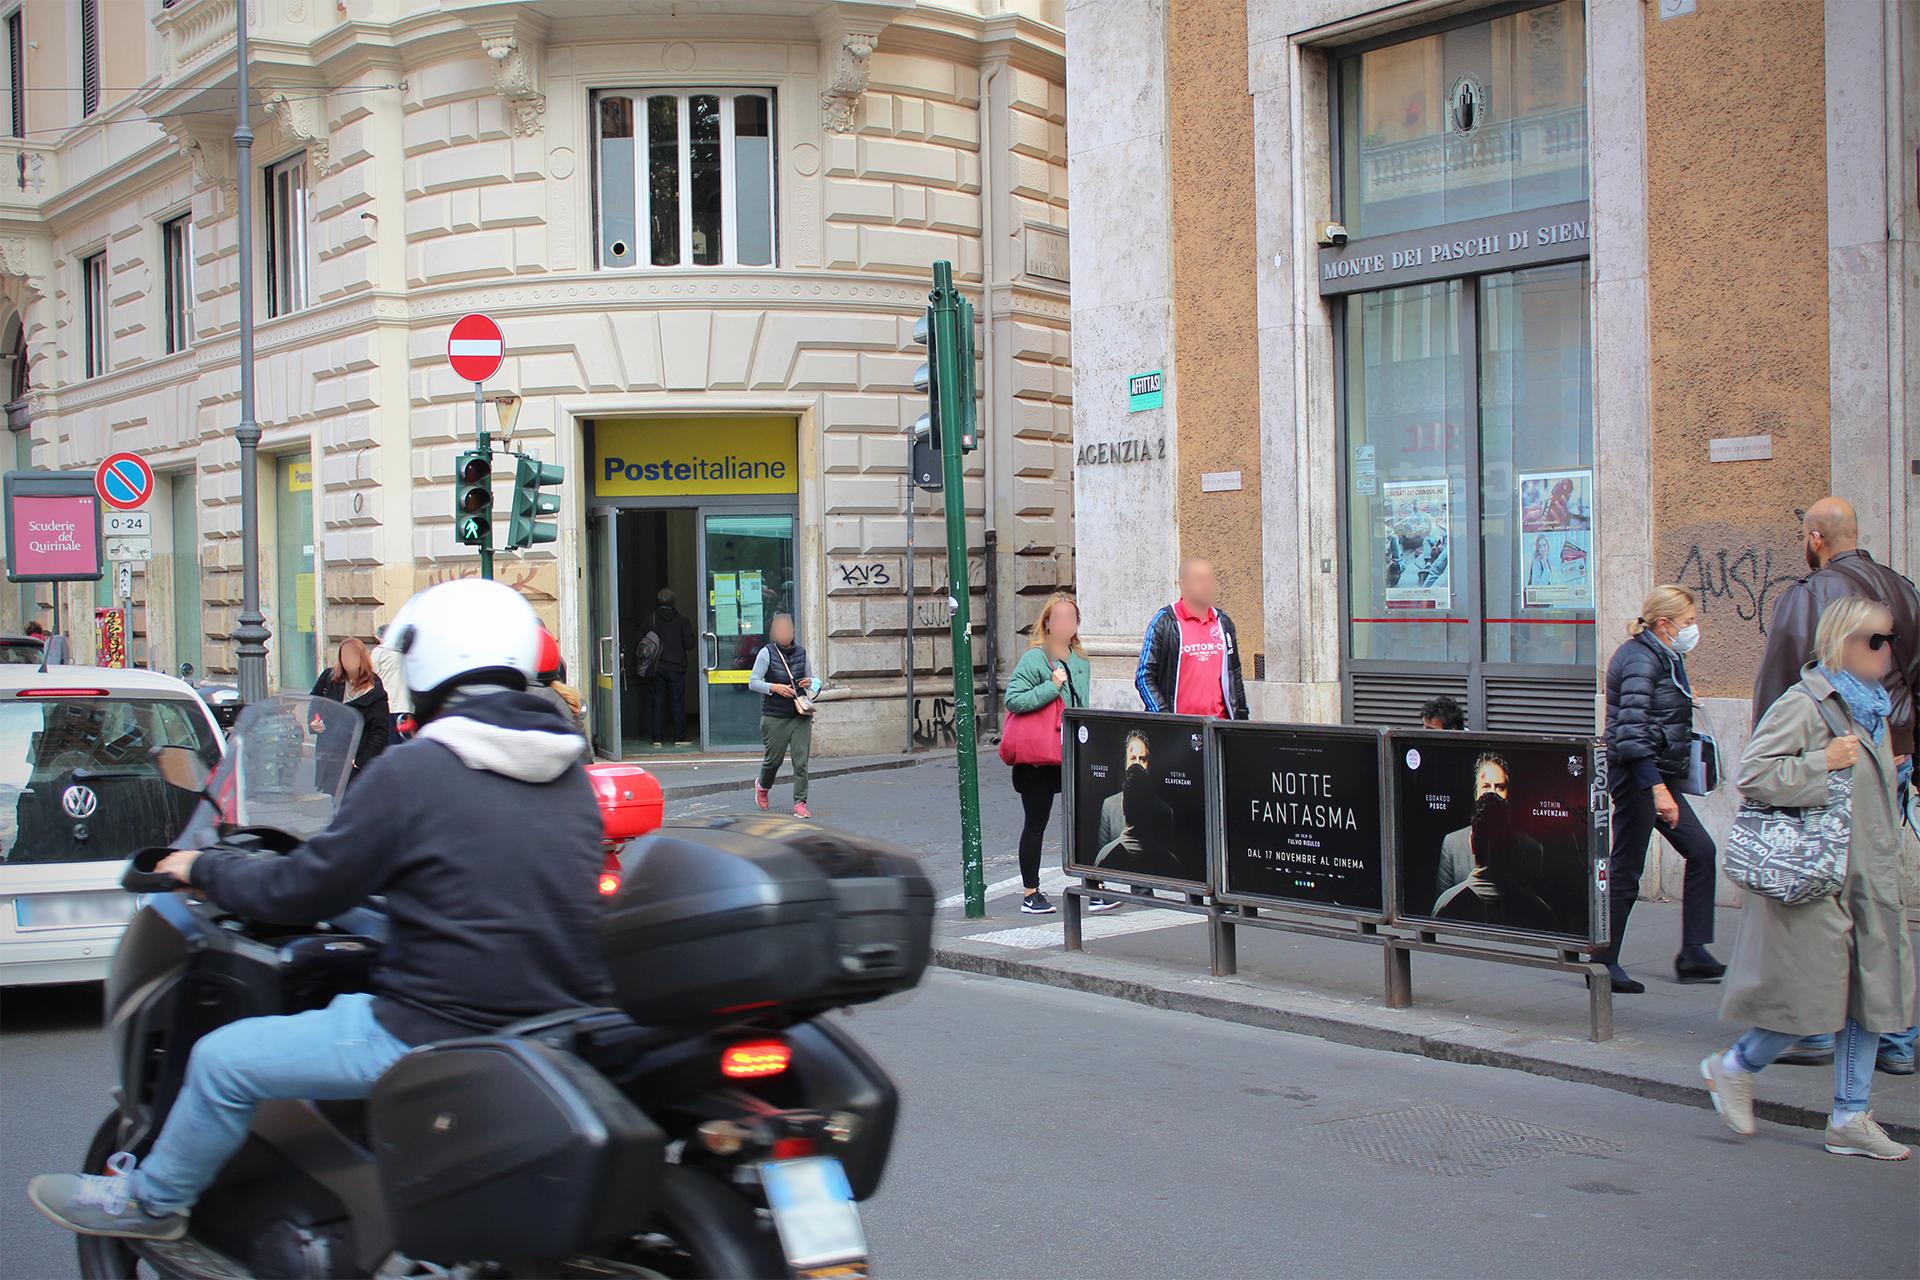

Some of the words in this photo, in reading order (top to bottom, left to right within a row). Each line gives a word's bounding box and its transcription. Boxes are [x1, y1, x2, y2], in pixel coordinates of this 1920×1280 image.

[1323, 254, 1385, 280] MONTE
[1391, 247, 1423, 271] DEI
[1431, 235, 1500, 264] PASCHI
[1508, 230, 1529, 251] DI
[1537, 220, 1590, 246] SIEN
[1131, 374, 1161, 395] AFFITTASI
[1077, 438, 1152, 466] AGENZIA
[1158, 438, 1166, 460] 2
[604, 456, 786, 481] Posteitaliane
[29, 520, 76, 531] Scuderie
[58, 531, 73, 542] del
[29, 541, 81, 553] Quirinale
[1272, 771, 1332, 797] NOTTE
[1425, 794, 1451, 802] EDOARDO
[1429, 802, 1447, 810] PESCE
[1540, 800, 1561, 808] YOTHIN
[1251, 800, 1357, 830] FANTASMA
[1532, 808, 1569, 817] CLAVENZANI
[1247, 848, 1262, 858] DAL
[1265, 850, 1273, 859] 17
[1276, 851, 1317, 865] NOVEMBRE
[1320, 856, 1330, 866] AL
[1333, 857, 1365, 869] CINEMA
